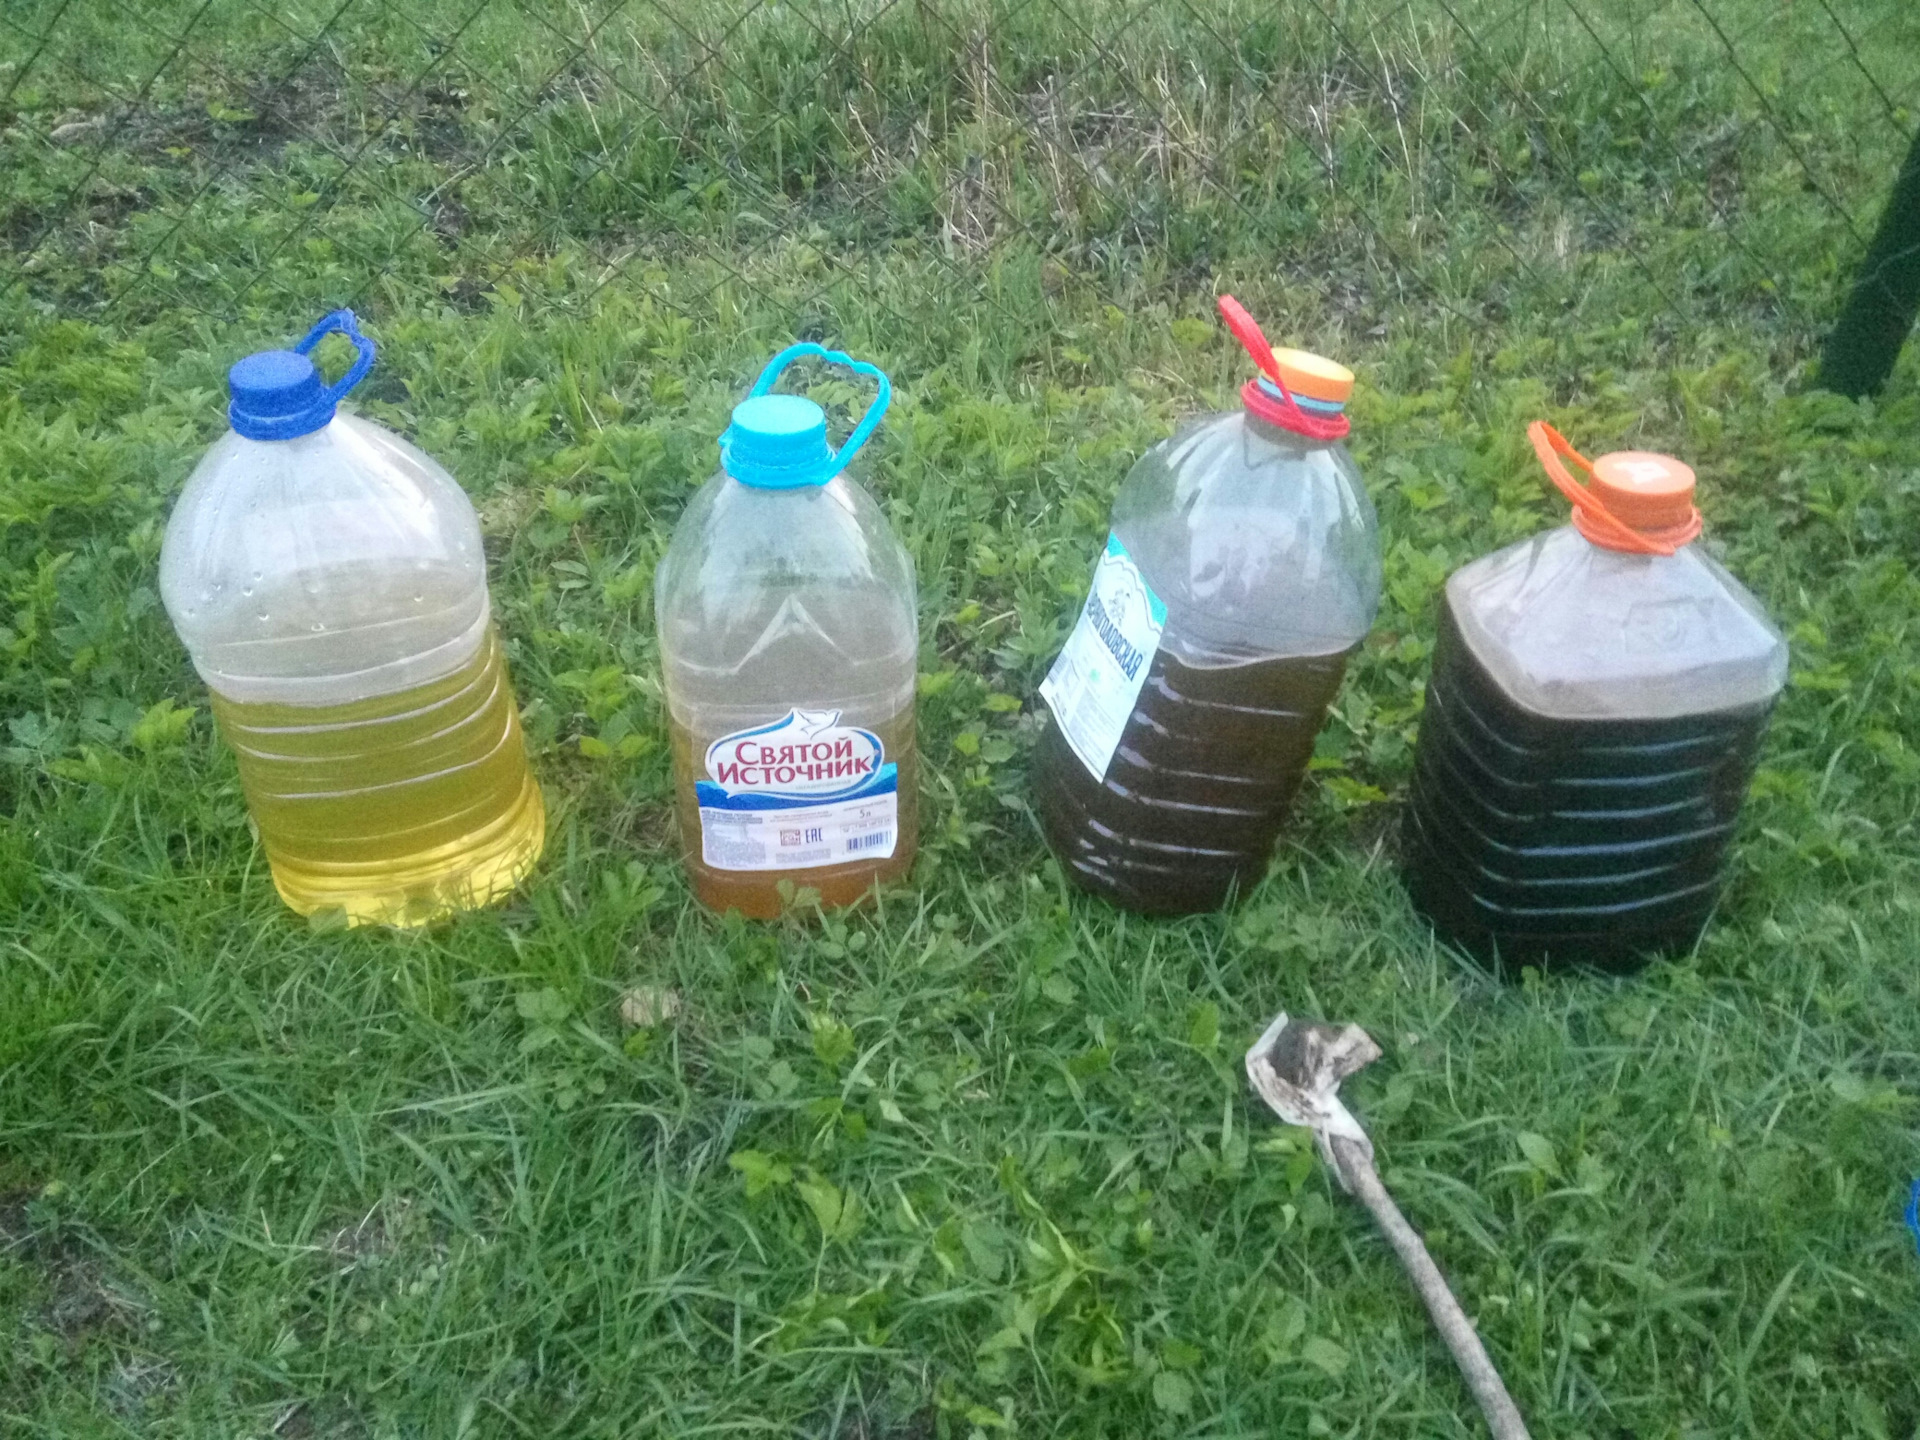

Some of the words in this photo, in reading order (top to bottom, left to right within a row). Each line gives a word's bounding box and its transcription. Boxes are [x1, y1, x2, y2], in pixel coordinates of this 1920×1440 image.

[735, 736, 853, 766] СВЯТОЙ
[717, 755, 873, 785] ИСТОЧНИК
[859, 808, 866, 819] 5
